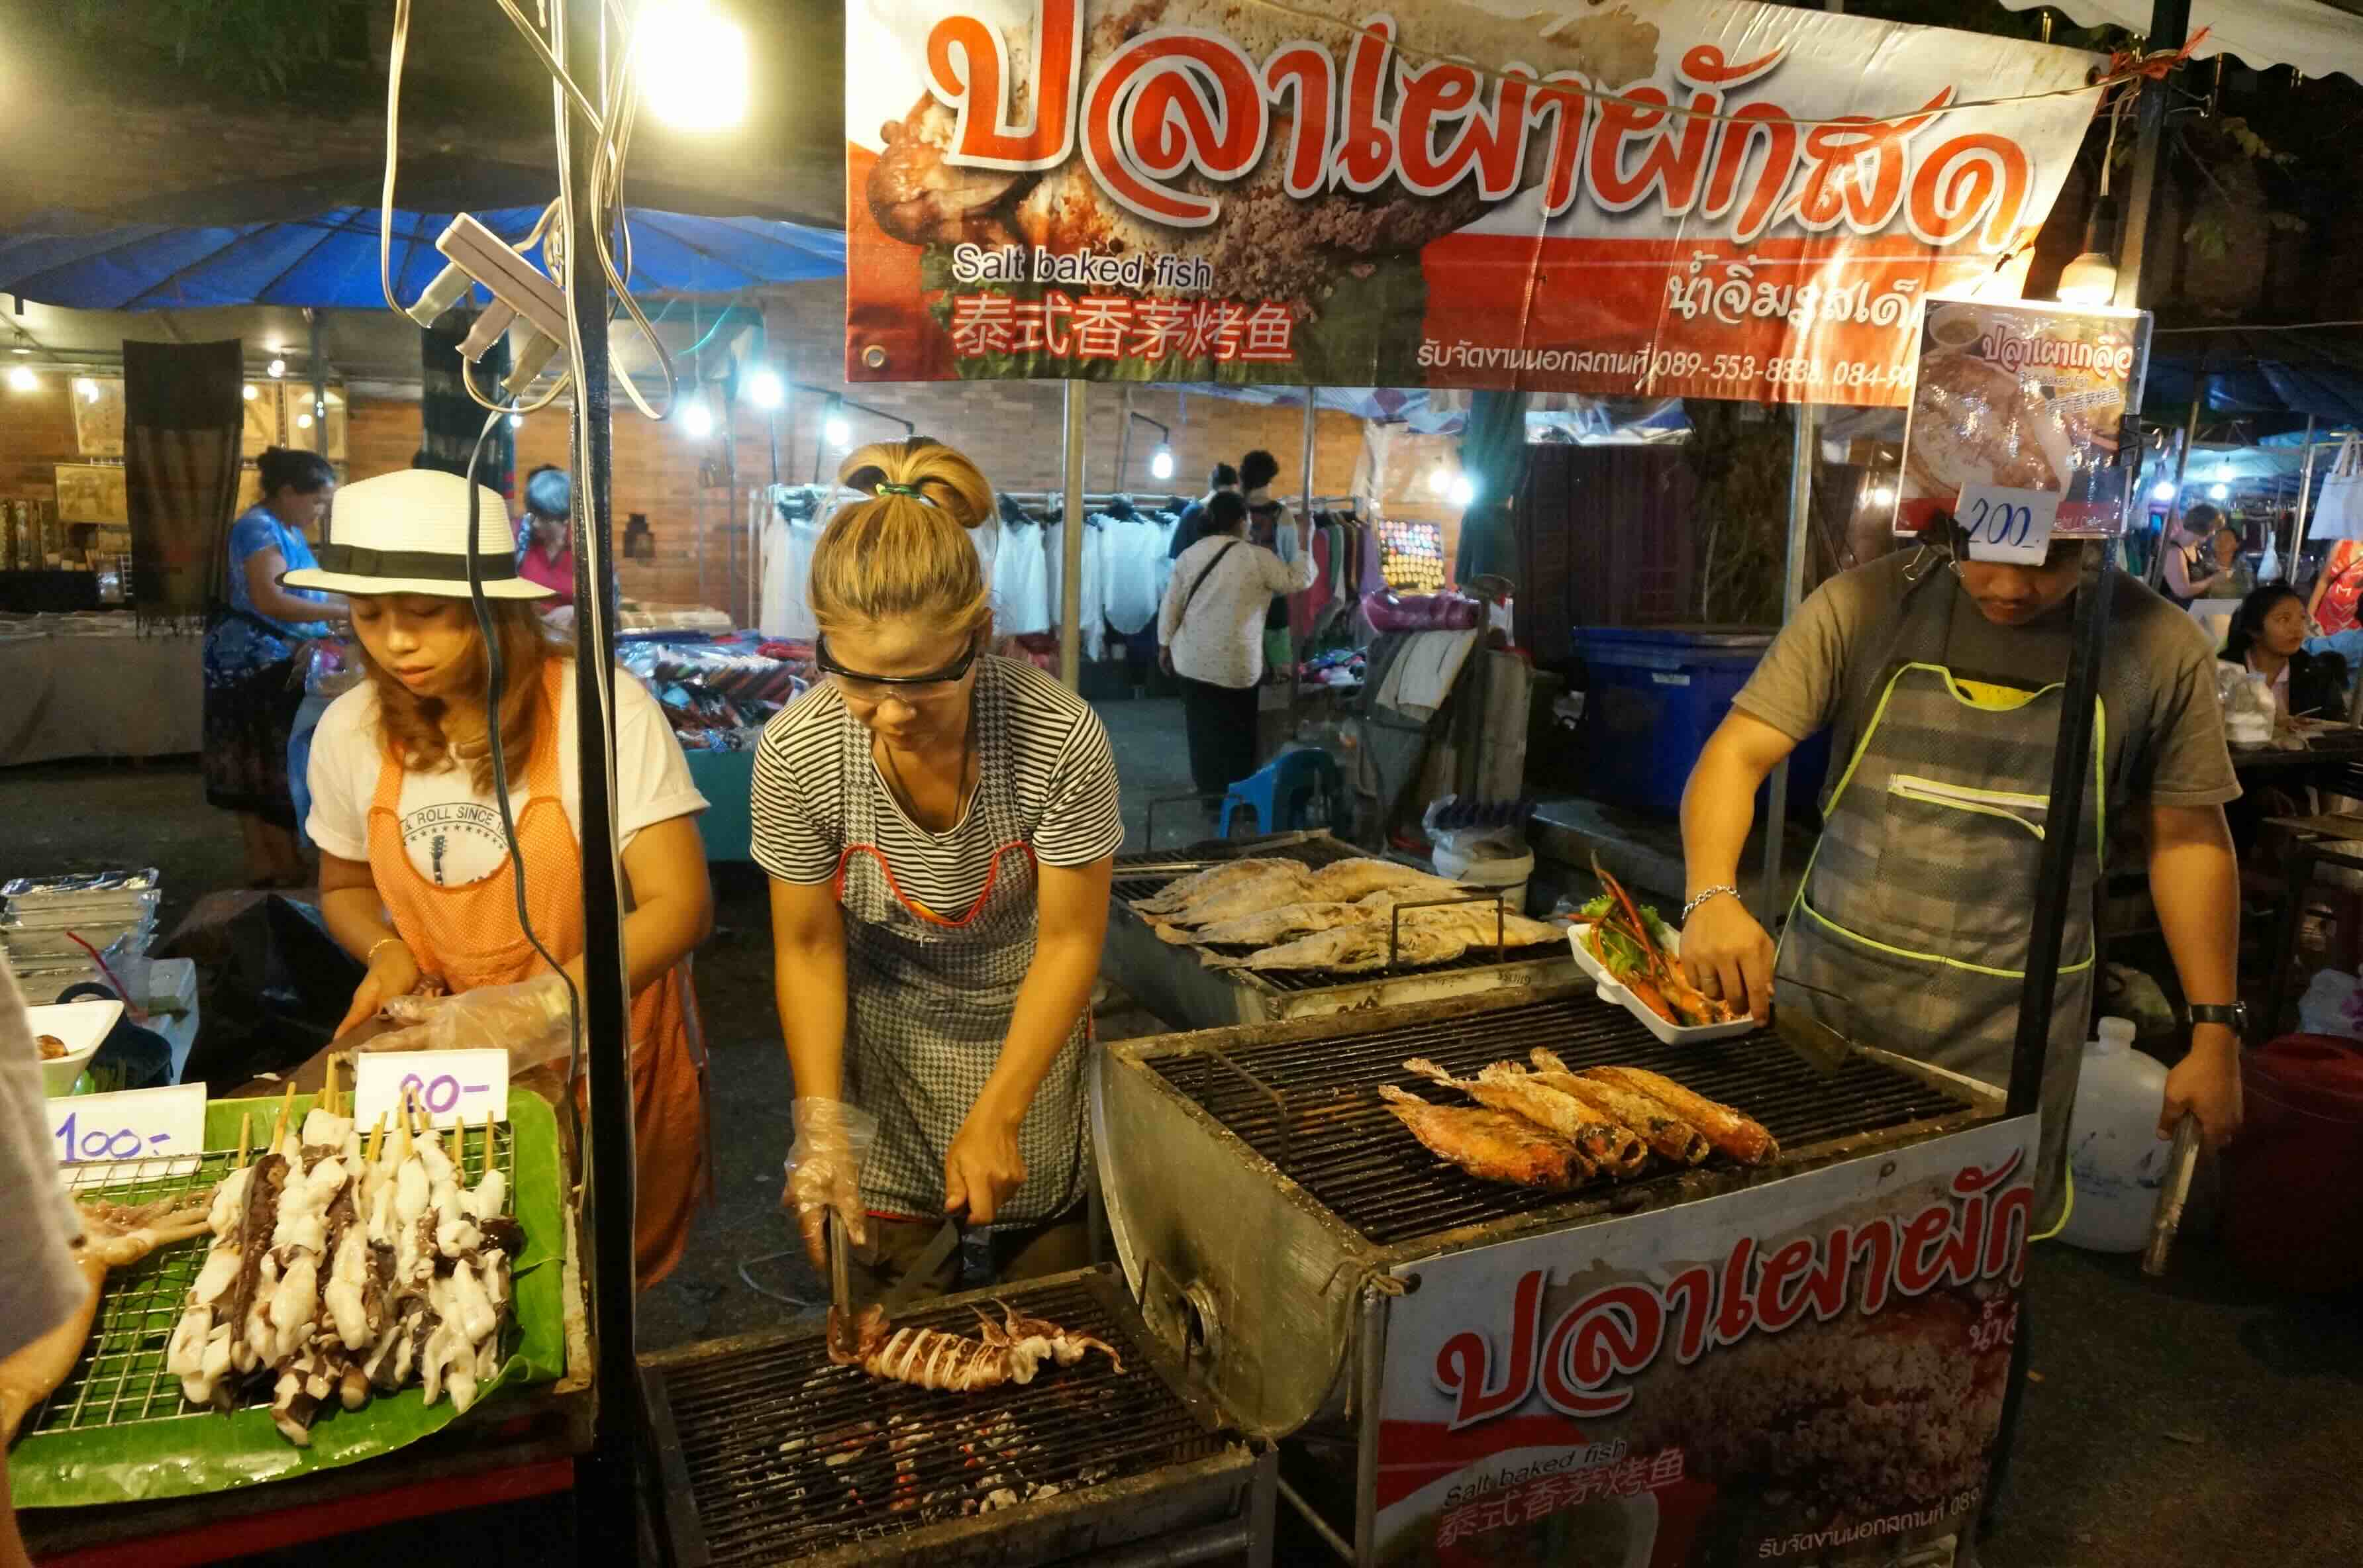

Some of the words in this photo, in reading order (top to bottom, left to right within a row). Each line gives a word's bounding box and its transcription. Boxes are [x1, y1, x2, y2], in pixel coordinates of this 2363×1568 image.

[927, 0, 2035, 254] ปลาเผาผักสด
[953, 243, 1025, 283] Salt
[1033, 246, 1144, 287] baked
[1154, 254, 1213, 289] fish
[952, 293, 1293, 359] 泰式香茅烤鱼
[1417, 338, 1652, 375] รับจัดงานนอกสถานที่
[417, 808, 451, 825] ROLL
[456, 806, 494, 826] SINCE
[1436, 1447, 1685, 1548] 泰式香茅烤鱼
[1443, 1471, 1491, 1508] Salt
[1499, 1450, 1576, 1487] baked
[1584, 1437, 1628, 1467] fish
